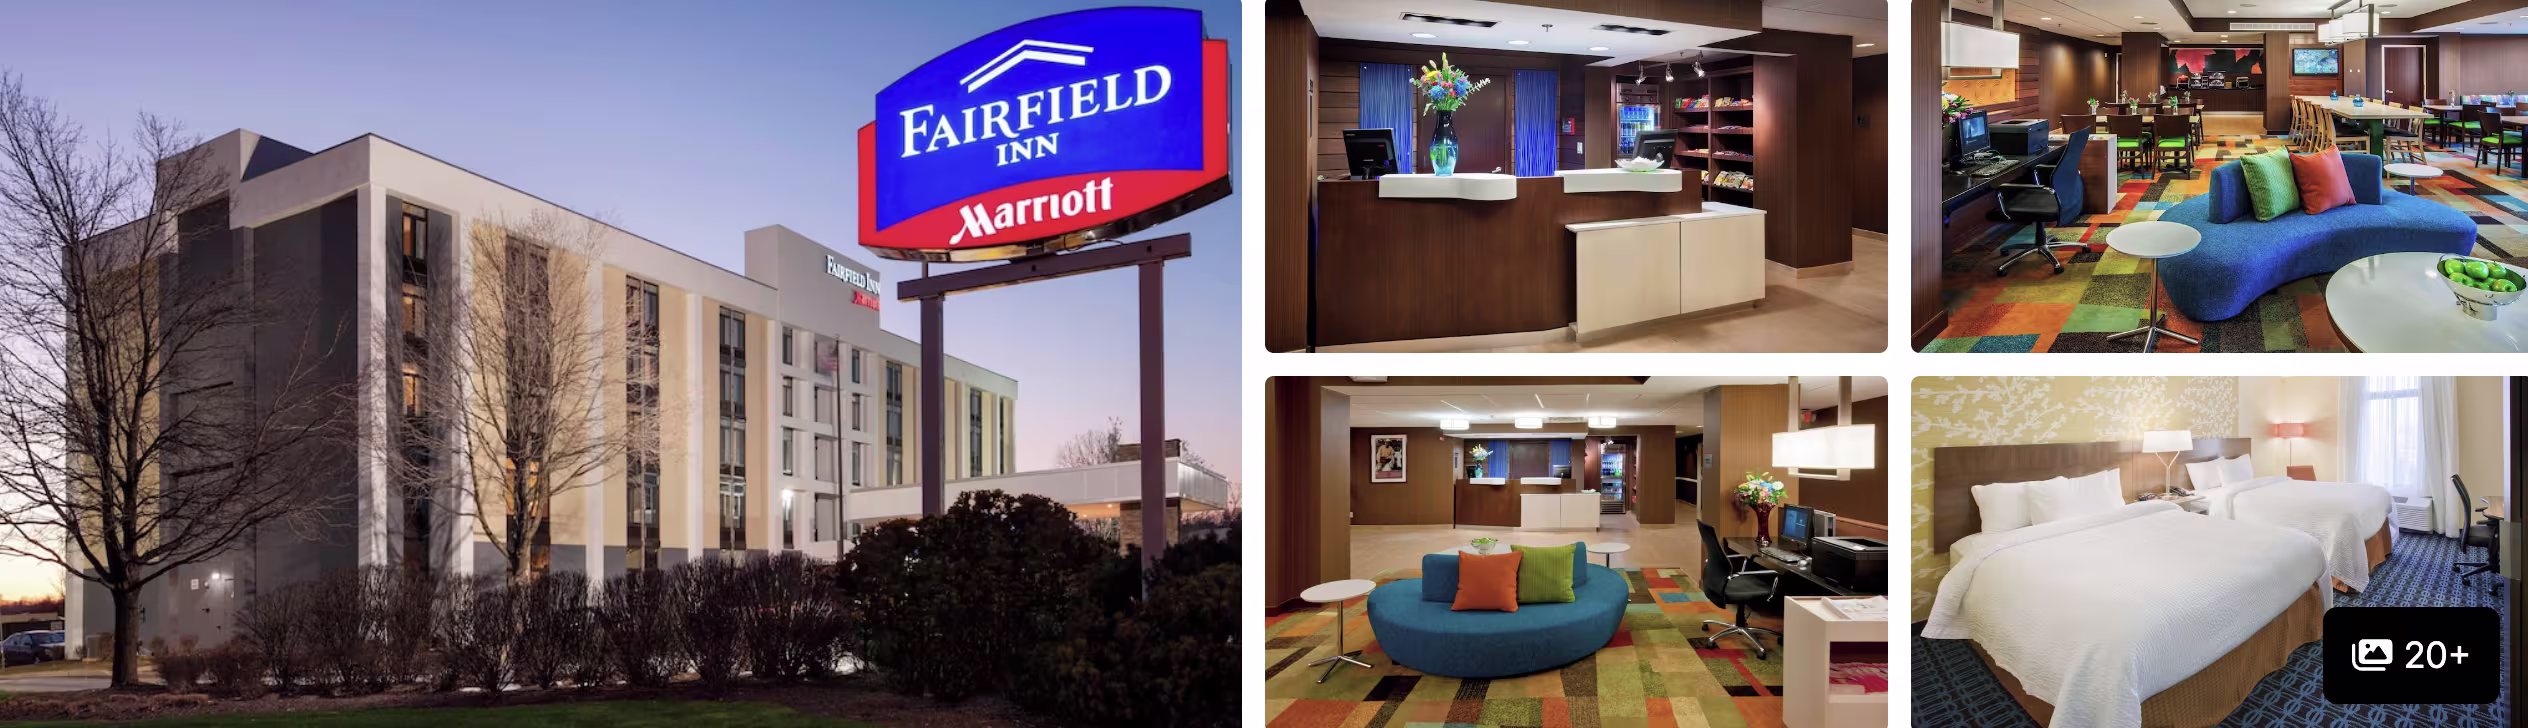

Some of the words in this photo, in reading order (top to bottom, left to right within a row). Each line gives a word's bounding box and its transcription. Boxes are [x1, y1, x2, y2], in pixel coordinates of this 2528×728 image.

[900, 64, 1172, 158] FAIRFIELD
[996, 132, 1060, 167] INN
[949, 177, 1113, 245] Marriott
[826, 254, 866, 288] FAIRFIELD
